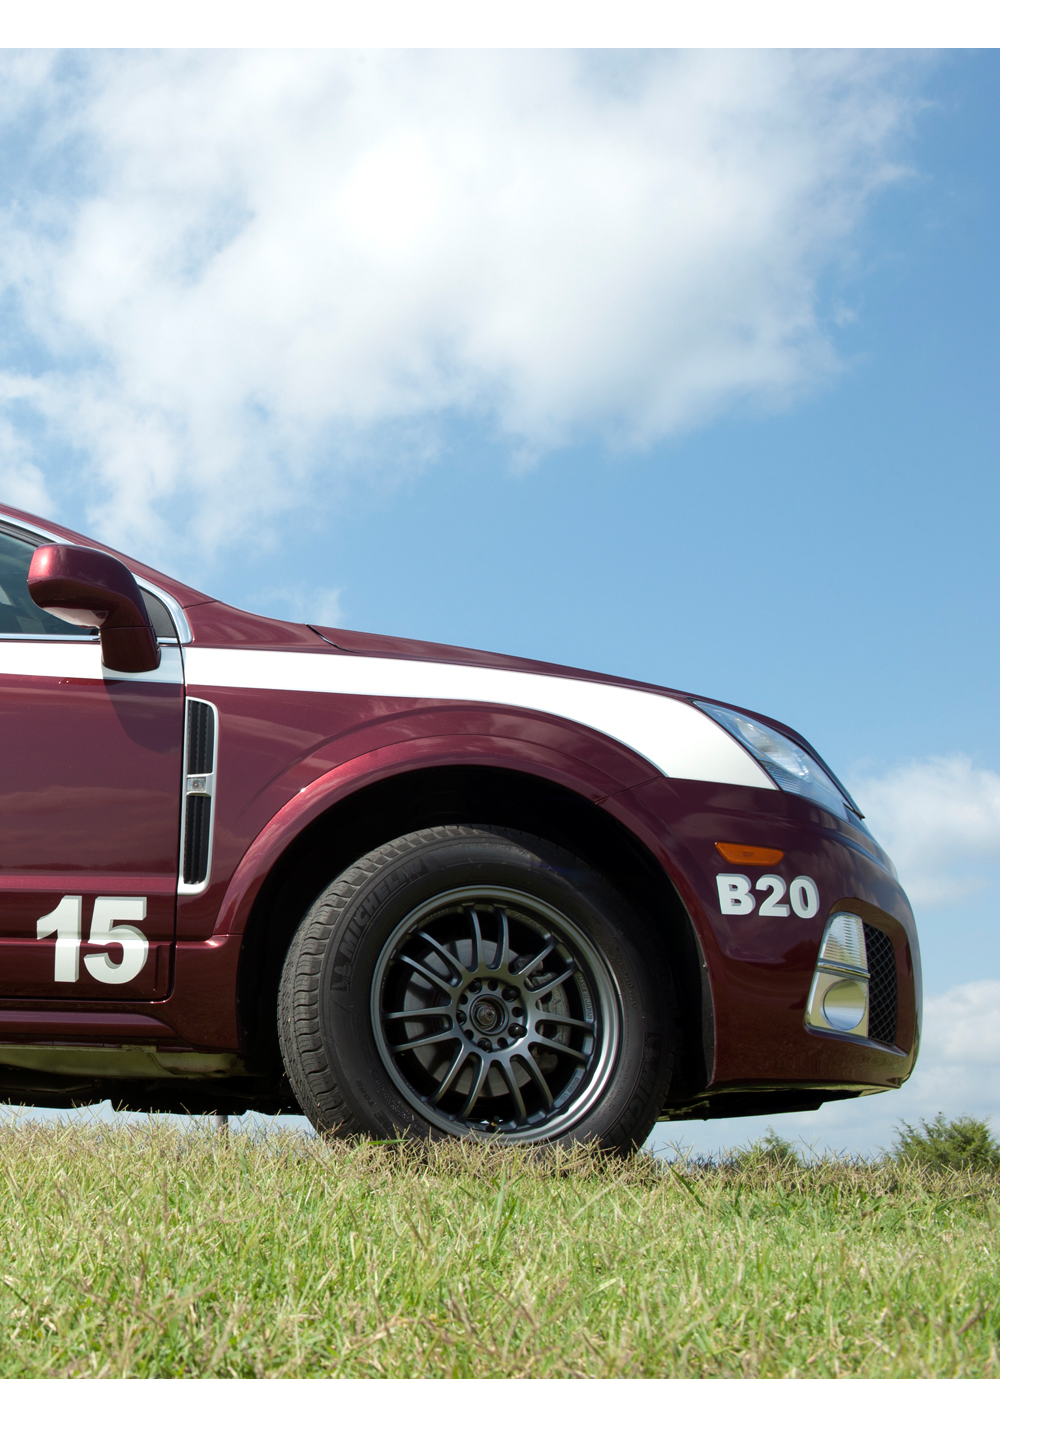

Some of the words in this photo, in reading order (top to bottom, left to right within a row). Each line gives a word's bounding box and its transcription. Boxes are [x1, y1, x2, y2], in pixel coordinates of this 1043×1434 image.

[36, 894, 149, 985] 15
[338, 859, 425, 958] MICHELIN
[715, 872, 820, 919] B20
